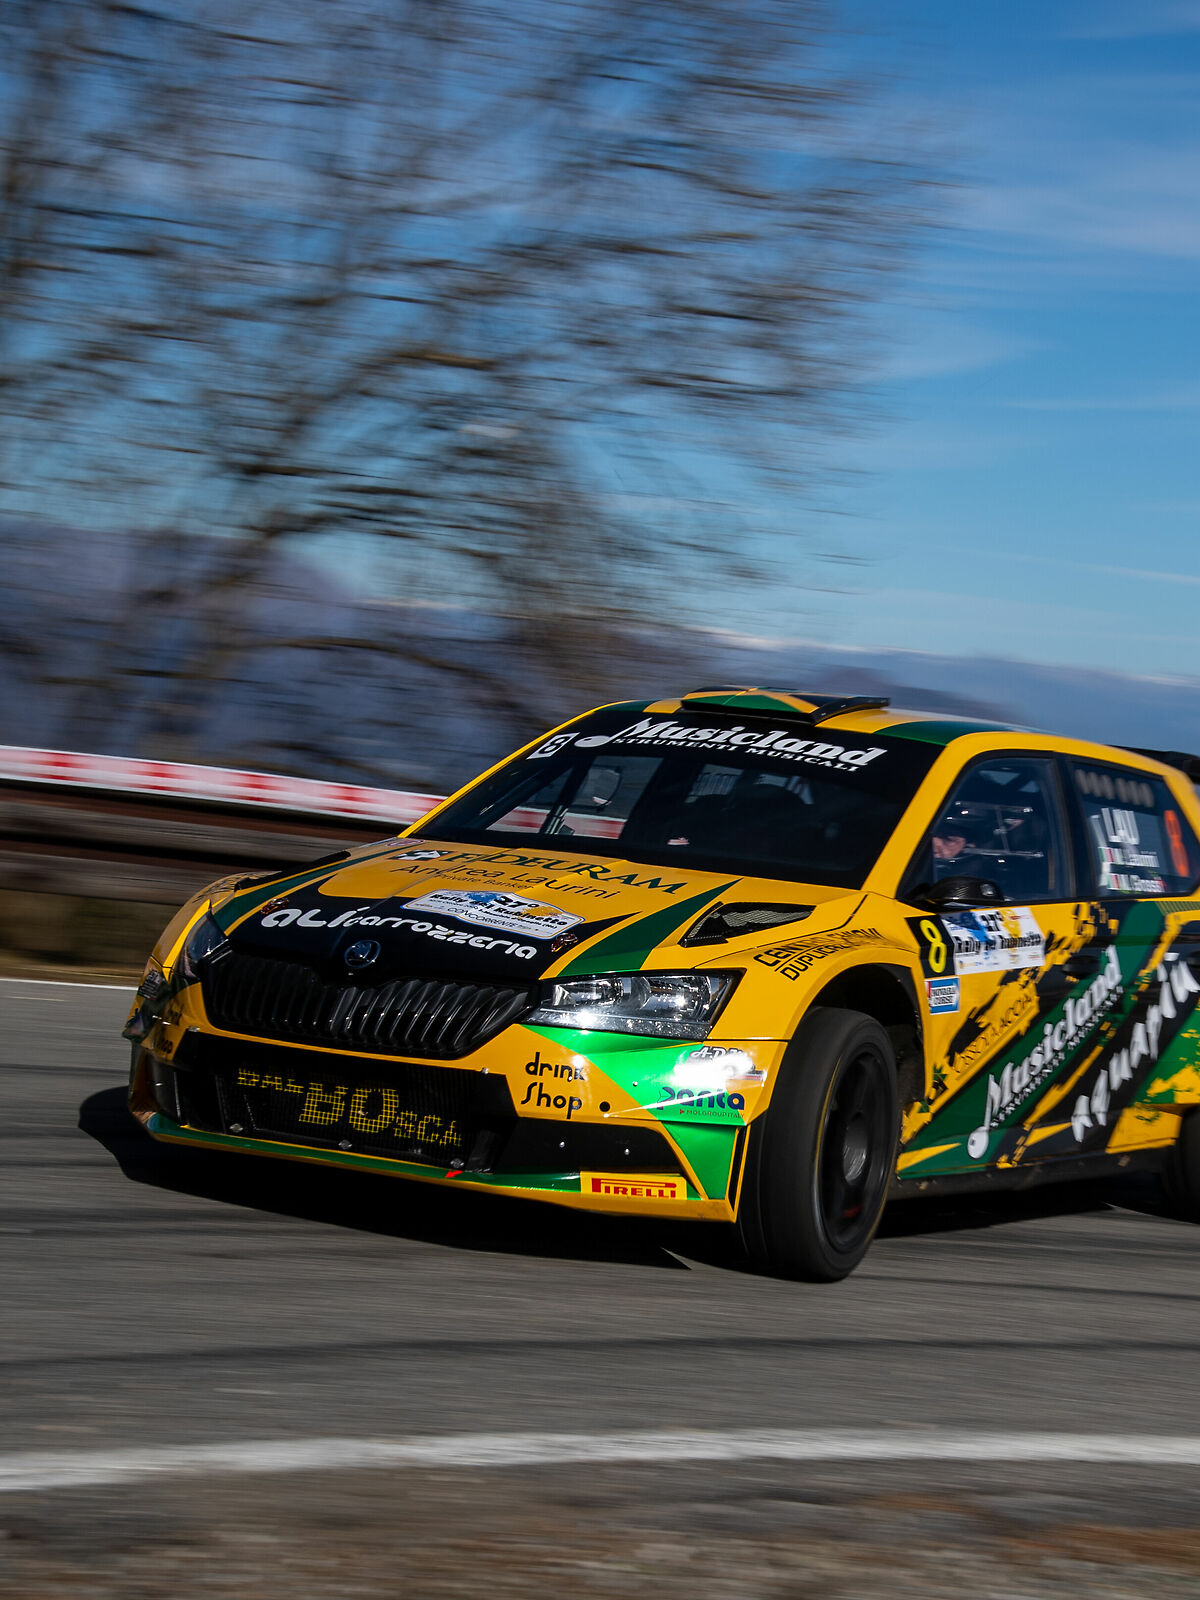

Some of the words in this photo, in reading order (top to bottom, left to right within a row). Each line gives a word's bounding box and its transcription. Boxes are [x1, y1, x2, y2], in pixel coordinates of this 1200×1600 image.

[538, 736, 571, 755] 8
[606, 717, 888, 766] Musicland
[612, 738, 737, 754] STRUMENTI
[746, 748, 858, 772] MUSICALI
[1164, 809, 1189, 877] 8
[483, 876, 534, 889] Banker
[510, 871, 621, 900] Laurini
[447, 907, 518, 928] CONCORRENTE
[494, 907, 567, 925] Rubinetto
[920, 919, 947, 974] 8
[984, 944, 1122, 1112] Musicland
[525, 1051, 585, 1081] drink
[591, 1177, 677, 1199] PIRELLI
